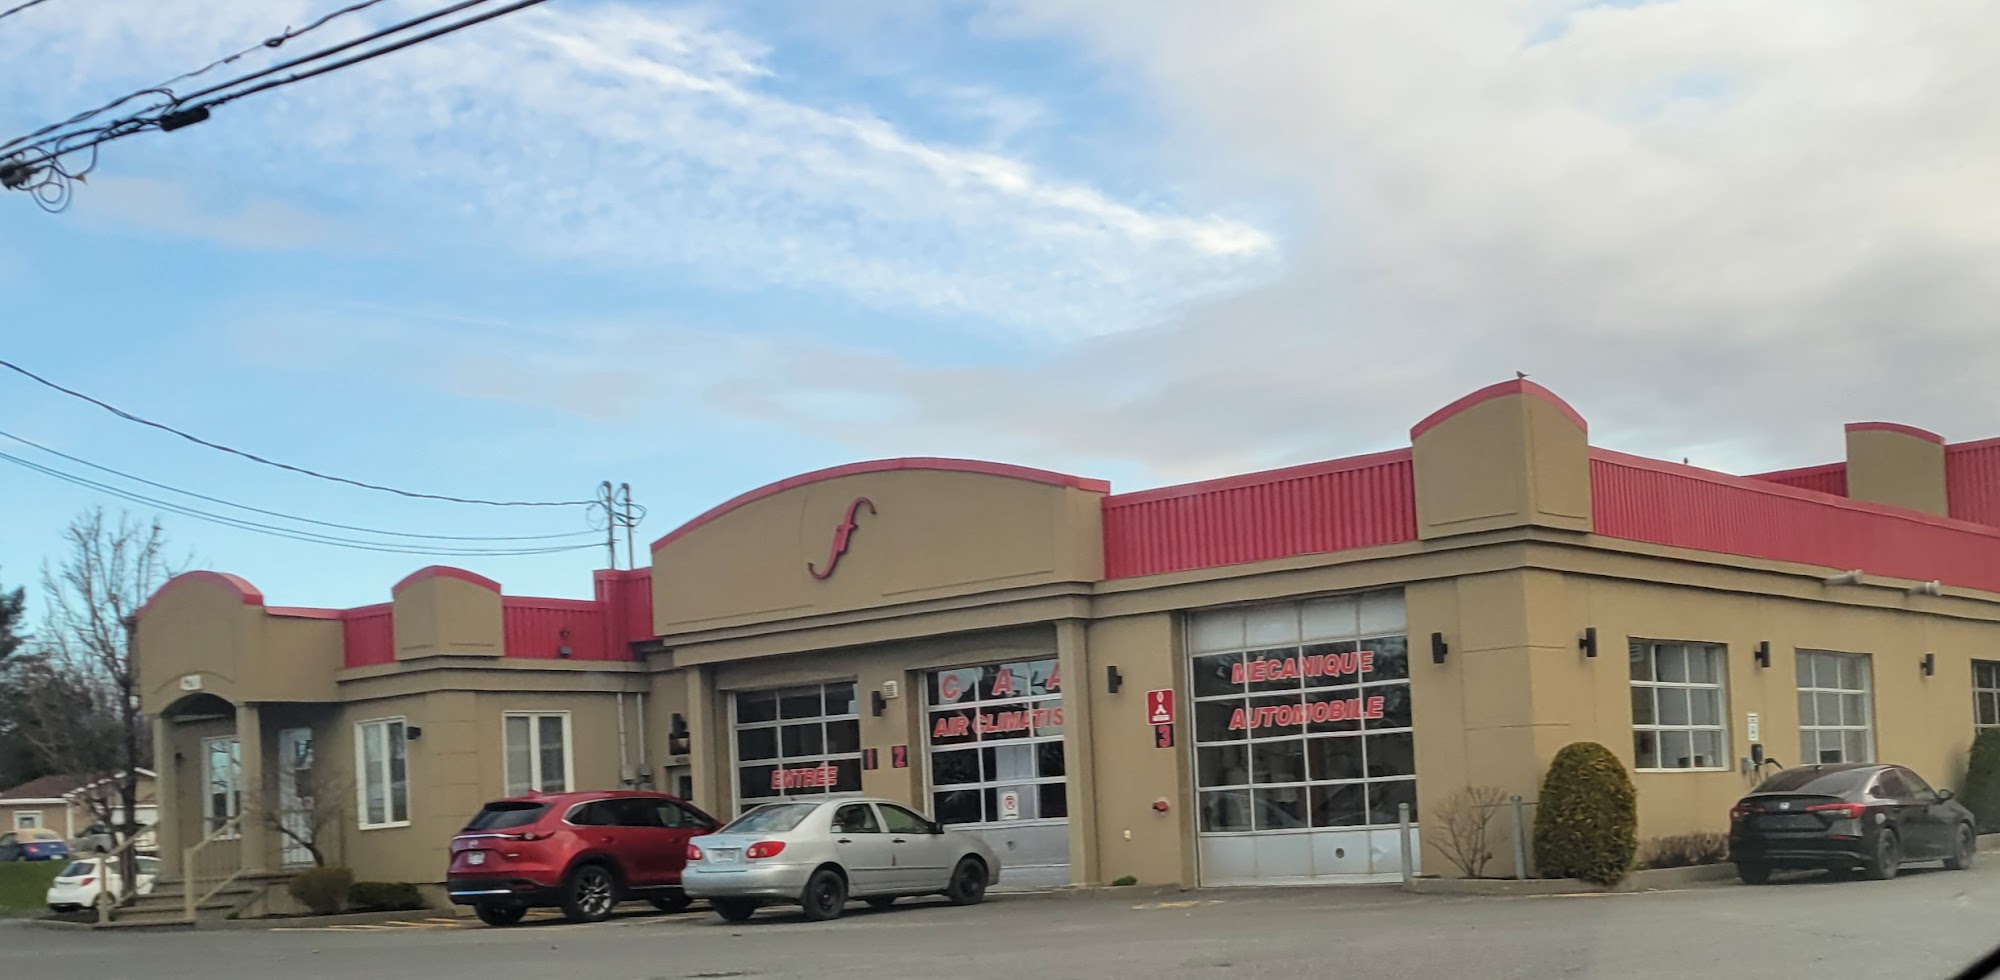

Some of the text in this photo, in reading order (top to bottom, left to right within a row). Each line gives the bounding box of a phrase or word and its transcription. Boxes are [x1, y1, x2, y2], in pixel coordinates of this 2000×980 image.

[1231, 650, 1374, 684] MÉCANIQUE
[1228, 696, 1385, 730] AUTOMOBILE
[933, 715, 970, 738] AIR
[1158, 724, 1171, 748] 3
[893, 746, 906, 768] 2
[771, 762, 838, 789] ENTRÉE
